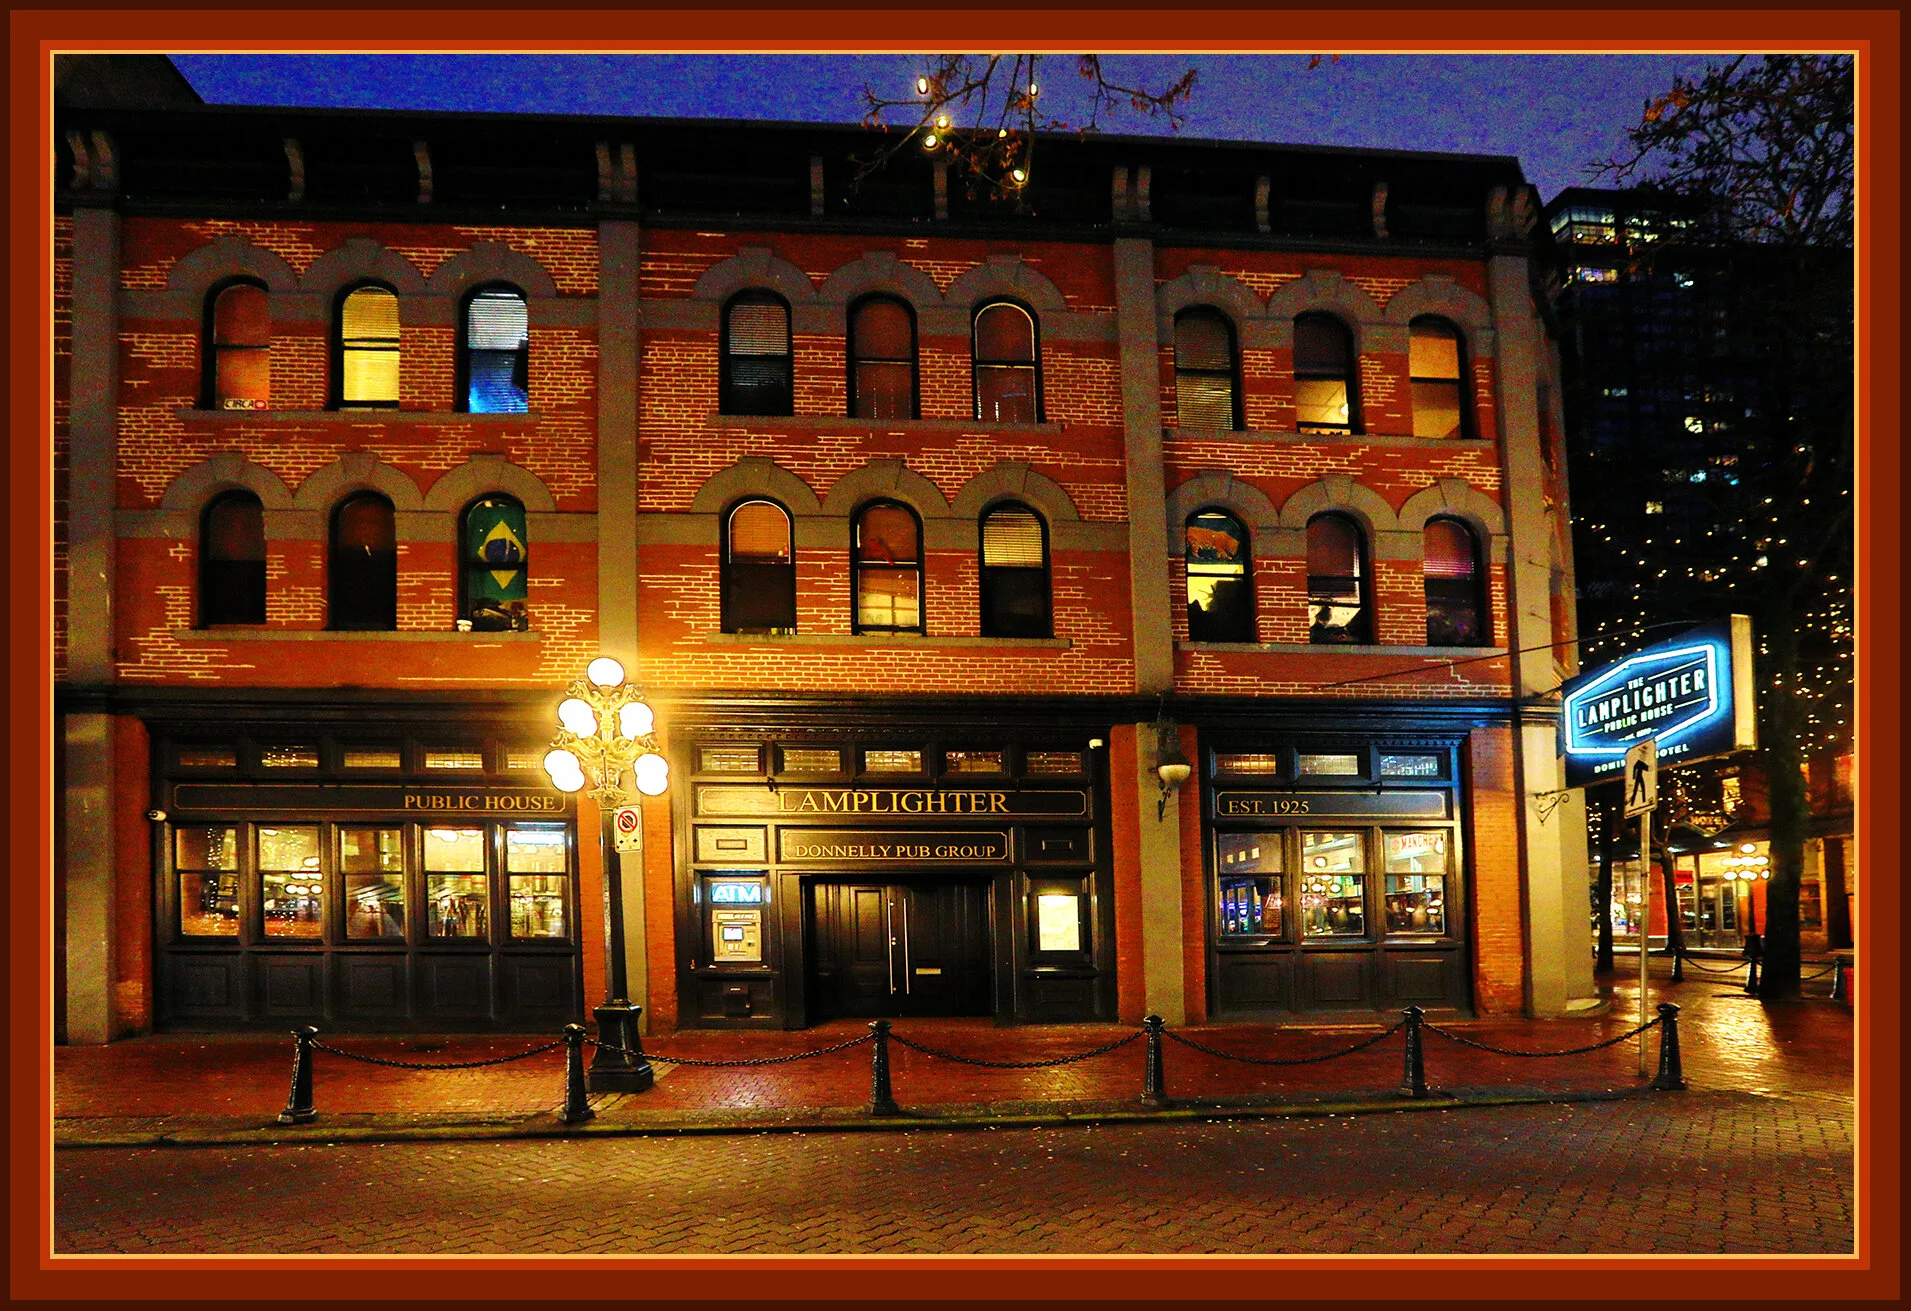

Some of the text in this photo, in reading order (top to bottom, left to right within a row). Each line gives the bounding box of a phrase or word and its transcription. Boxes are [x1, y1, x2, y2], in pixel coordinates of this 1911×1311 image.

[1627, 677, 1645, 690] THE
[1578, 668, 1706, 728] LAMPLIGHTER
[1604, 703, 1674, 733] PUBLIC HOUSE
[1594, 760, 1627, 773] DOMIN
[404, 795, 556, 810] PUBLIC HOUSE
[778, 791, 1011, 813] LAMPLIGHTER
[1228, 800, 1310, 814] EST. 1925
[795, 845, 996, 858] DONNELLY PUB GROUP
[714, 885, 761, 902] ATM
